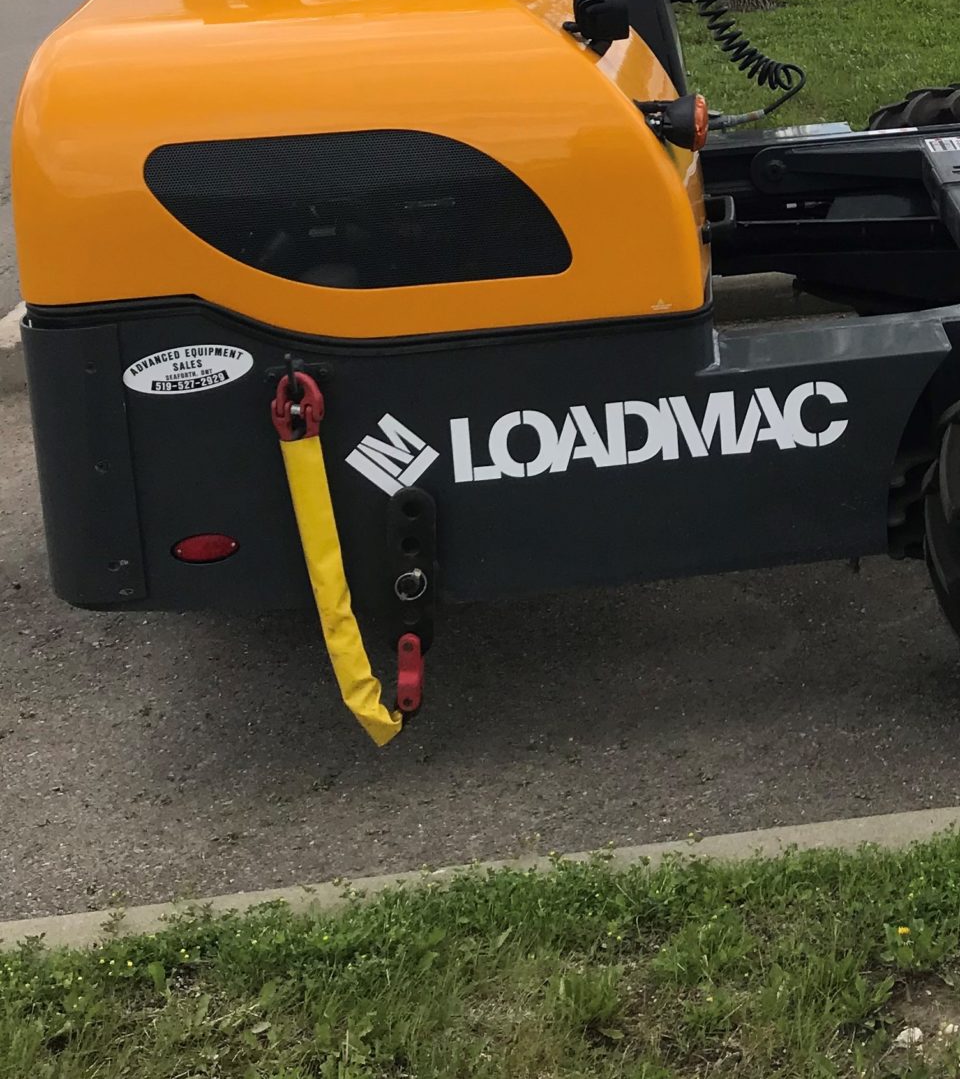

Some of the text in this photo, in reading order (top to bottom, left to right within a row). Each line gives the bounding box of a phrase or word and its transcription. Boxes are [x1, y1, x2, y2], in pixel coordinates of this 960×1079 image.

[129, 346, 244, 376] ADVANCED EQUIPMENT
[172, 359, 203, 371] SALES
[155, 372, 226, 391] 519-527-2929
[449, 381, 849, 484] LOADMAC
